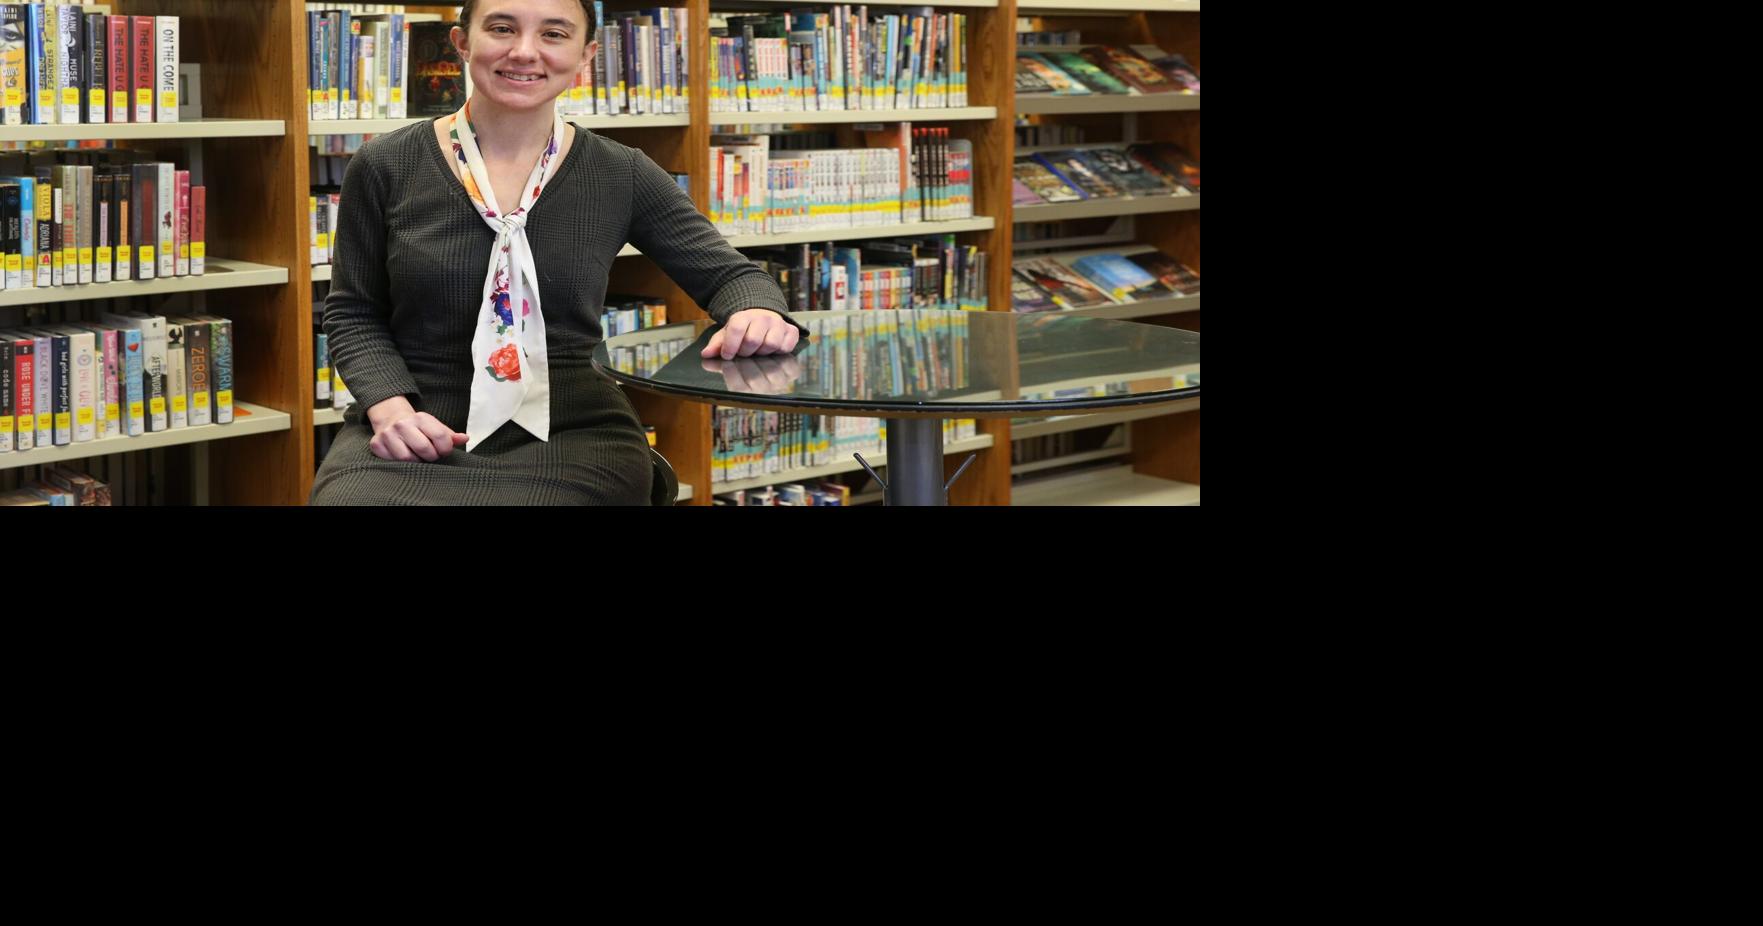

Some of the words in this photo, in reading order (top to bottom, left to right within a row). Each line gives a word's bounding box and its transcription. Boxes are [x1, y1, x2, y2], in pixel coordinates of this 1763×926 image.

[69, 11, 77, 32] LAINI
[114, 28, 124, 46] THE
[139, 28, 149, 46] THE
[162, 29, 174, 43] ON
[114, 48, 124, 74] HATE
[139, 48, 149, 74] HATE
[162, 45, 174, 62] THE
[69, 58, 77, 82] MUSE
[114, 75, 124, 83] U
[139, 75, 149, 83] U
[162, 64, 174, 92] COME
[42, 187, 50, 217] VIOLA
[39, 223, 50, 250] ADRIANA
[2, 369, 10, 388] code
[21, 361, 31, 381] ROSE
[191, 346, 209, 391] ZEROE
[21, 383, 31, 406] UNDER
